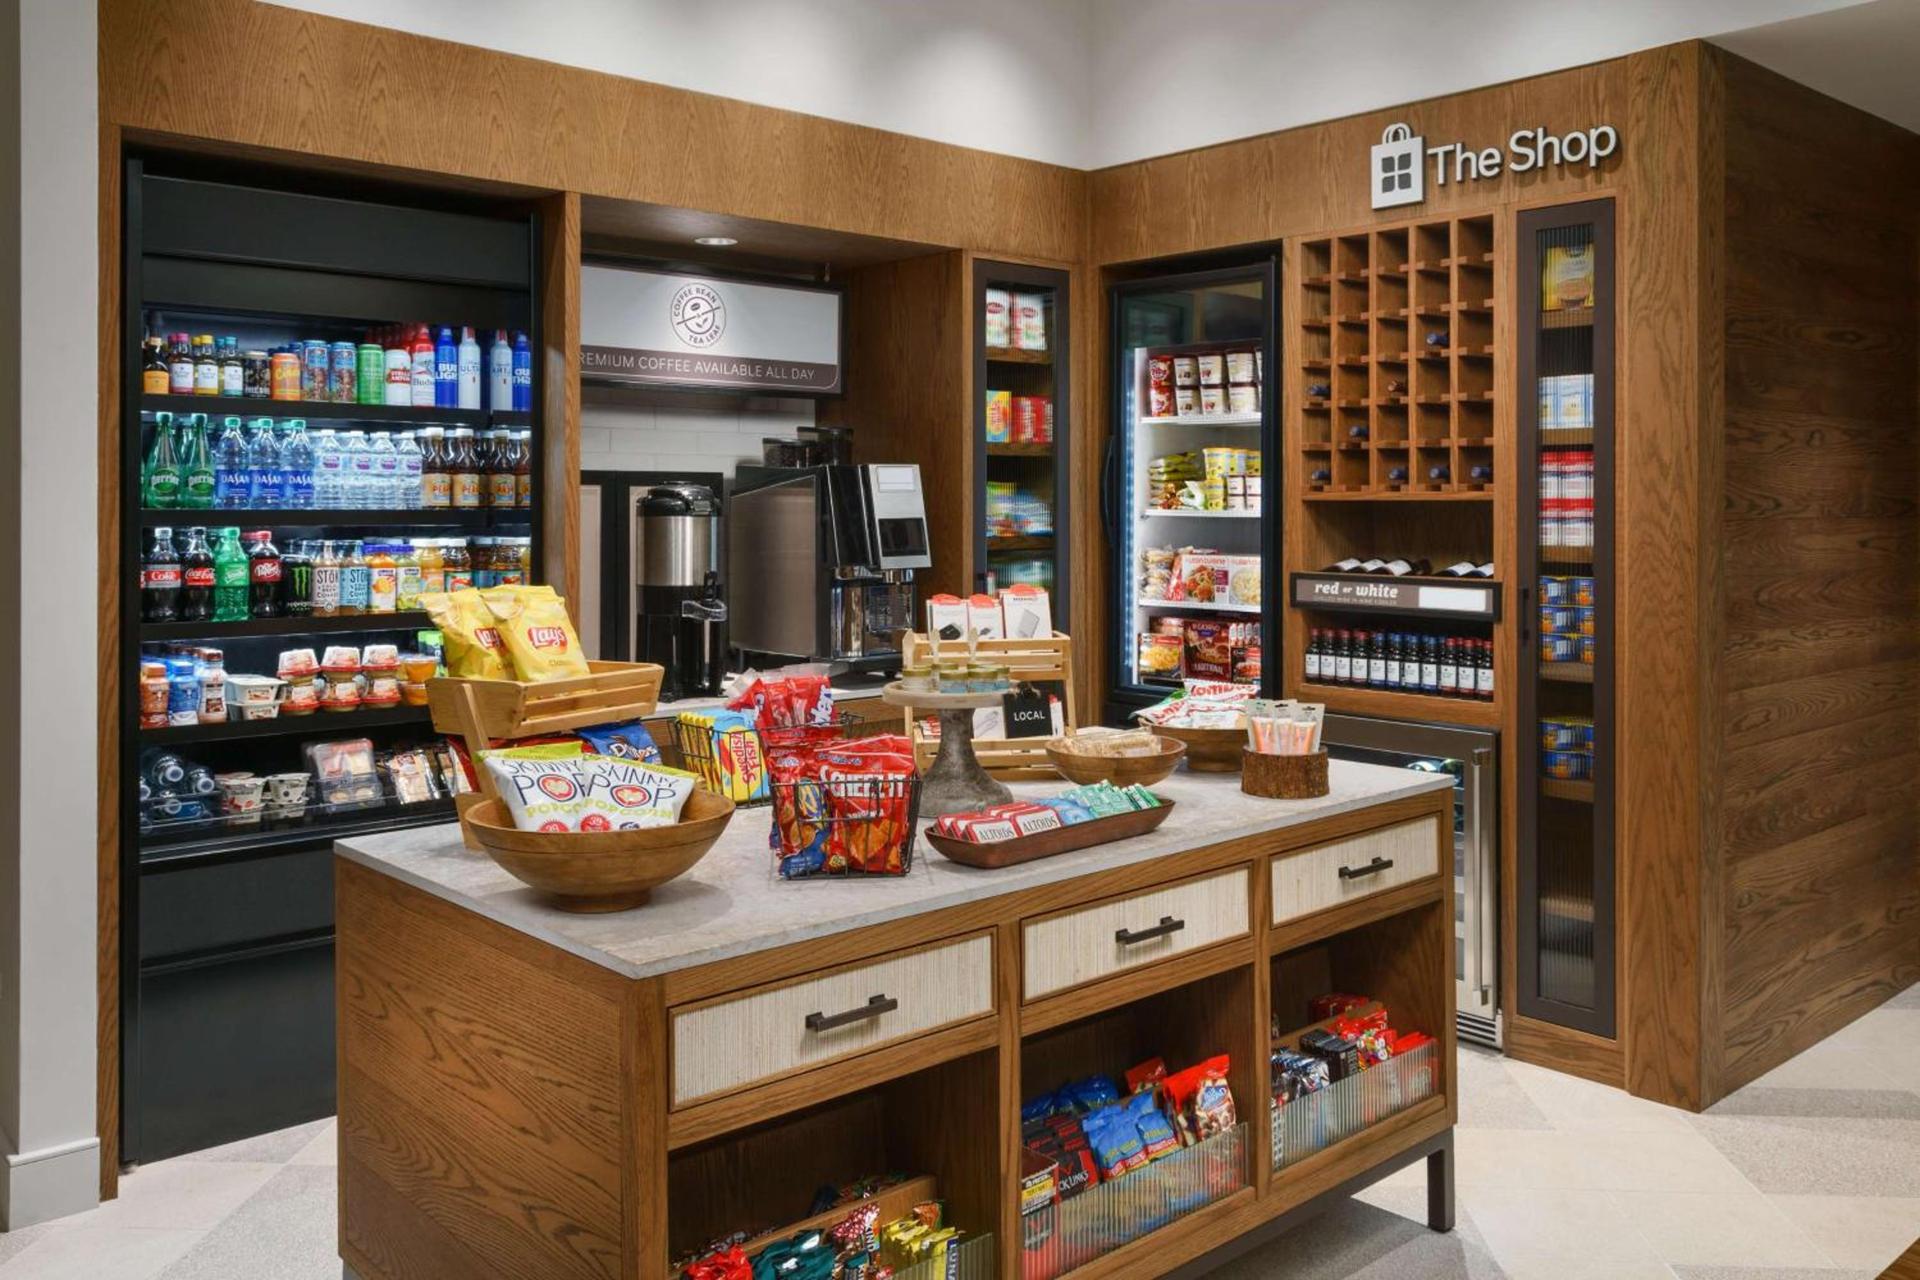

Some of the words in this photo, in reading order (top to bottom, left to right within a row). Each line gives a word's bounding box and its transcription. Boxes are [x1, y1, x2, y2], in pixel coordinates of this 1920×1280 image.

[1427, 142, 1501, 185] The
[1509, 124, 1617, 172] Shop
[673, 287, 693, 317] COFFEE
[695, 287, 717, 304] BEAN
[688, 333, 705, 345] TEA
[706, 324, 721, 342] LEAF
[579, 351, 635, 368] REMIUM
[637, 356, 691, 373] COFFEE
[694, 361, 763, 378] AVAILABLE
[765, 365, 788, 380] ALL
[791, 367, 815, 381] DAY
[151, 570, 177, 581] Coke
[1314, 582, 1340, 595] red
[1355, 584, 1398, 598] white
[1013, 710, 1046, 722] LOCAL
[502, 760, 582, 774] SKINNY
[597, 763, 680, 788] SKINNY
[587, 774, 677, 808] POP
[978, 826, 1015, 842] ALTOIDS
[1021, 815, 1059, 834] ALTOIDS
